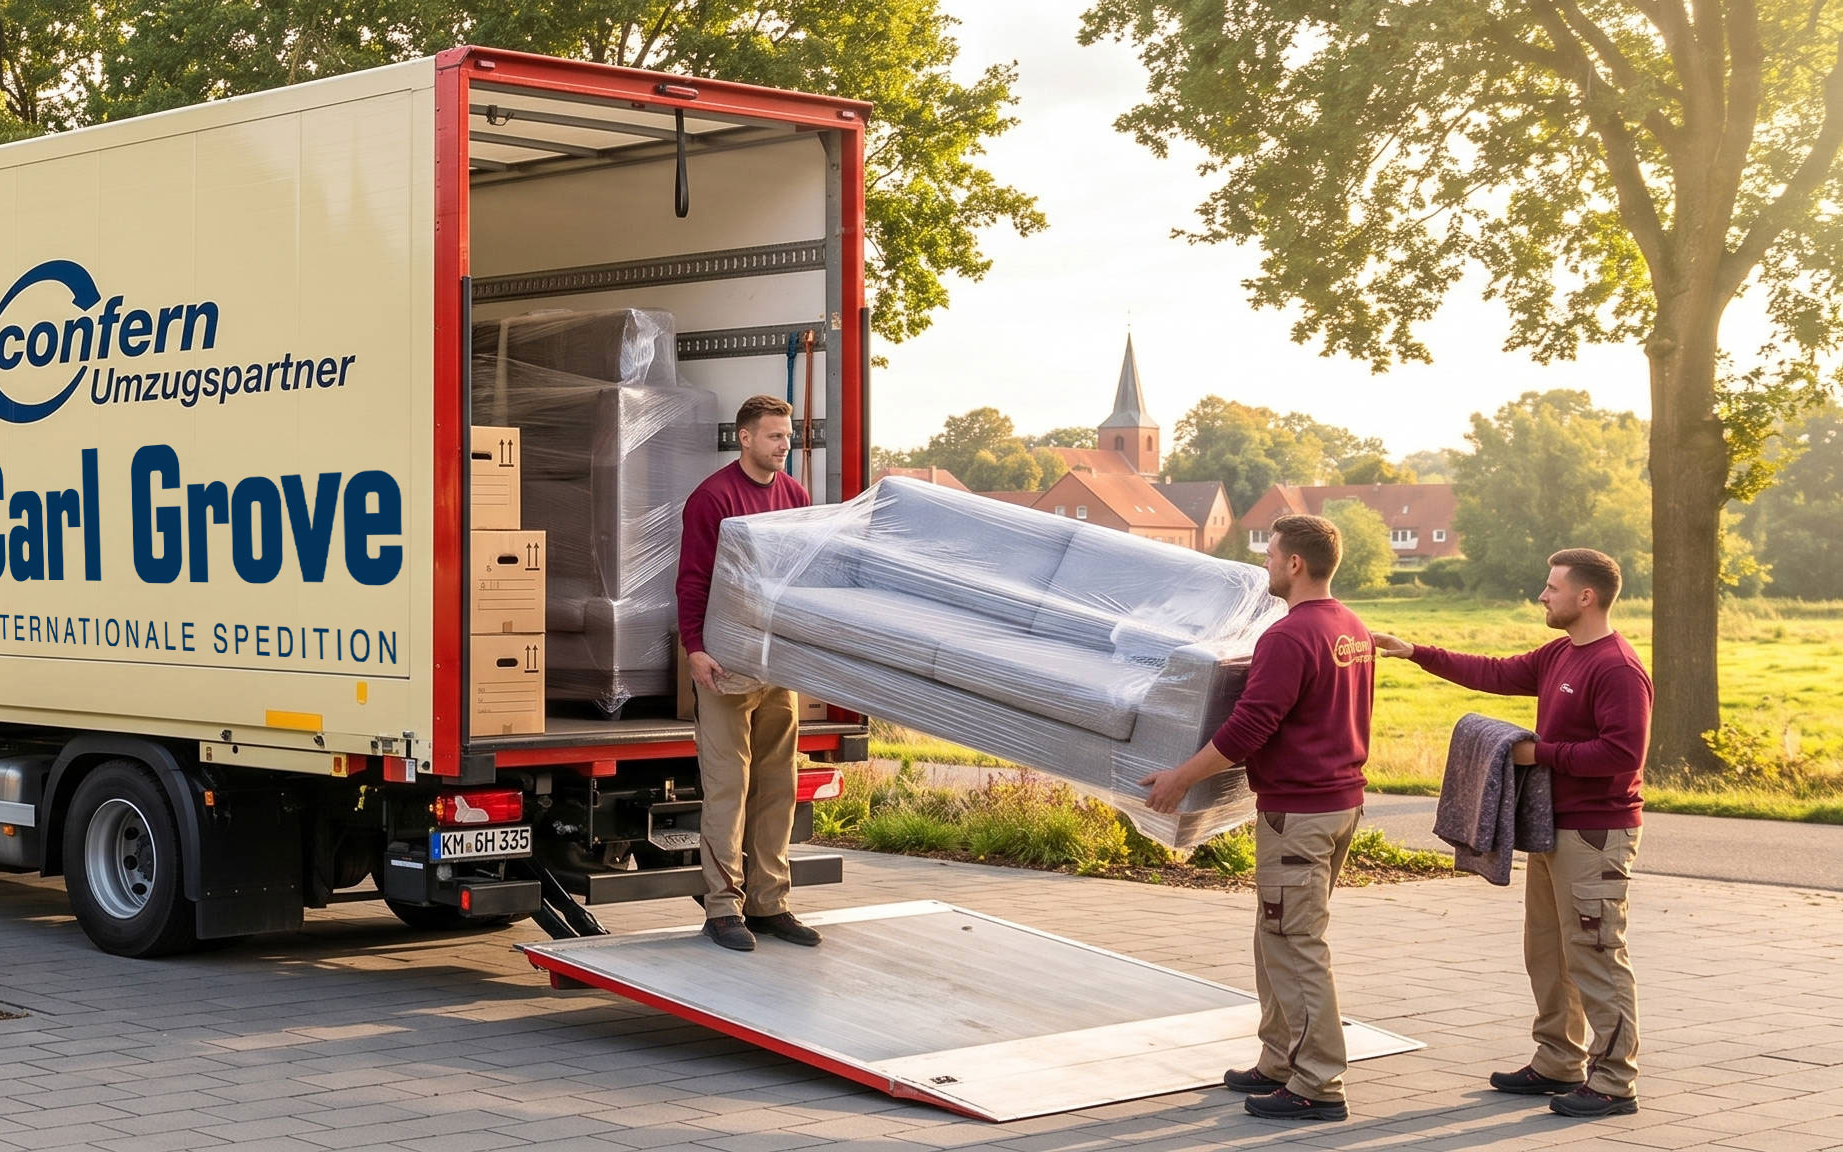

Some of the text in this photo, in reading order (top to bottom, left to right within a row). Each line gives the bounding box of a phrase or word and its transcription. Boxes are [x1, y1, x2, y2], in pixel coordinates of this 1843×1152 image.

[91, 354, 355, 408] Umzugspartner
[130, 444, 403, 586] Grove
[213, 622, 397, 665] SPEDITION
[442, 833, 464, 856] KM
[499, 829, 530, 851] 335
